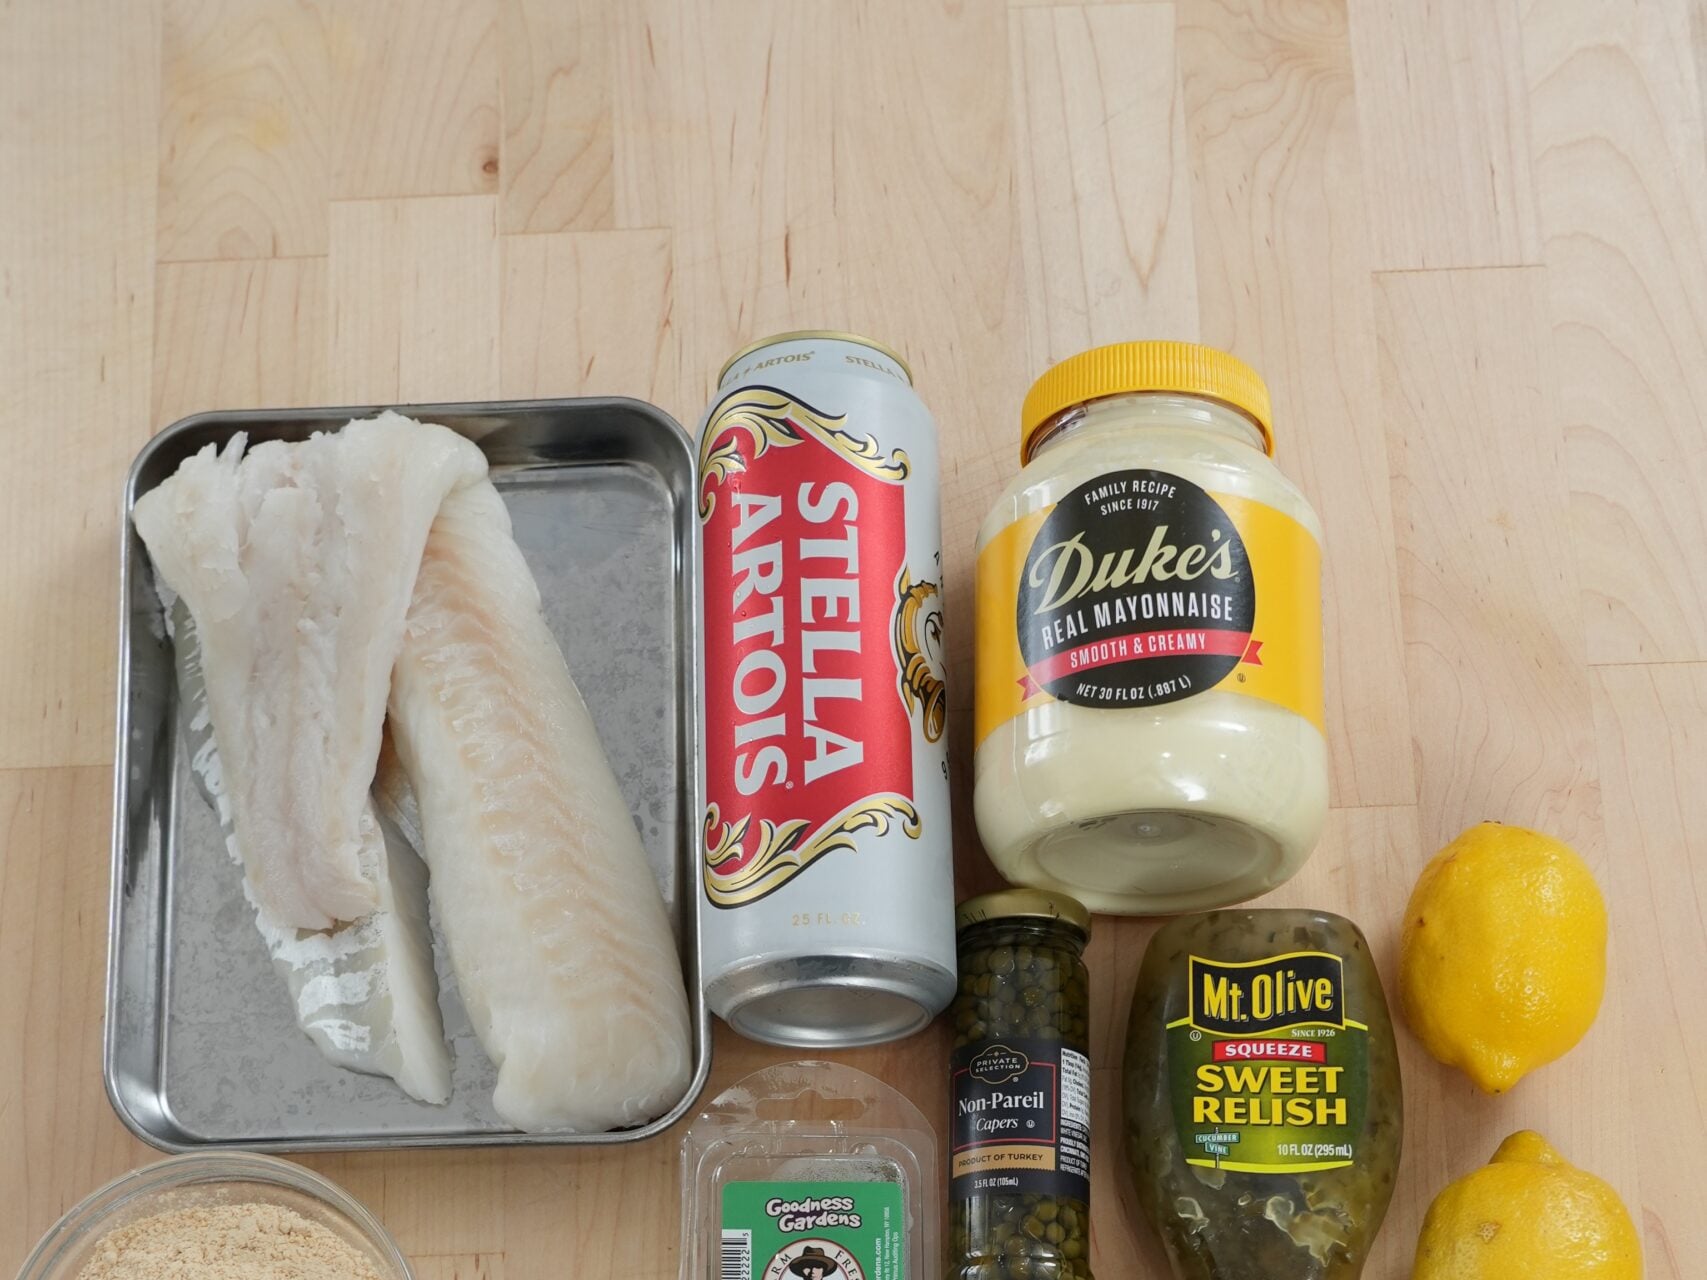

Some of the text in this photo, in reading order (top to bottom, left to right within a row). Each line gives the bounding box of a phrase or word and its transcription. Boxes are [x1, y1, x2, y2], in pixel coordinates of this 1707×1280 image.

[754, 353, 812, 371] ARTOIS
[1085, 480, 1177, 505] FAMILY RECIPE
[1100, 498, 1159, 516] SINCE 1917
[1028, 525, 1239, 616] Duke's
[1041, 592, 1233, 651] REAL MAYONNAISE
[731, 491, 788, 796] ARTOIS
[797, 481, 864, 786] STELLA
[1070, 632, 1207, 669] SMOOTH & CREAMY
[1076, 674, 1192, 701] NET 30 FL OZ (.887 L)
[791, 913, 811, 928] 25
[817, 912, 832, 926] FL
[1203, 969, 1334, 1022] Mt. Olive
[1291, 1028, 1336, 1038] SINCE 1926
[1224, 1043, 1313, 1058] SQUEEZE
[975, 1064, 1021, 1073] SELECTION
[976, 1057, 1018, 1067] PRIVATE
[1196, 1064, 1344, 1094] SWEET
[958, 1091, 1044, 1117] Non-Pareil
[1193, 1096, 1348, 1125] RELISH
[976, 1117, 1019, 1134] Capers
[1198, 1134, 1237, 1142] CUCUMBER
[1209, 1143, 1227, 1154] VINE
[1277, 1145, 1289, 1156] 10
[1302, 1145, 1313, 1156] OZ
[1314, 1144, 1335, 1158] (295
[958, 1153, 1044, 1168] PRODUCT OF TURKEY
[766, 1197, 854, 1217] Goodness
[778, 1211, 862, 1233] Gardens
